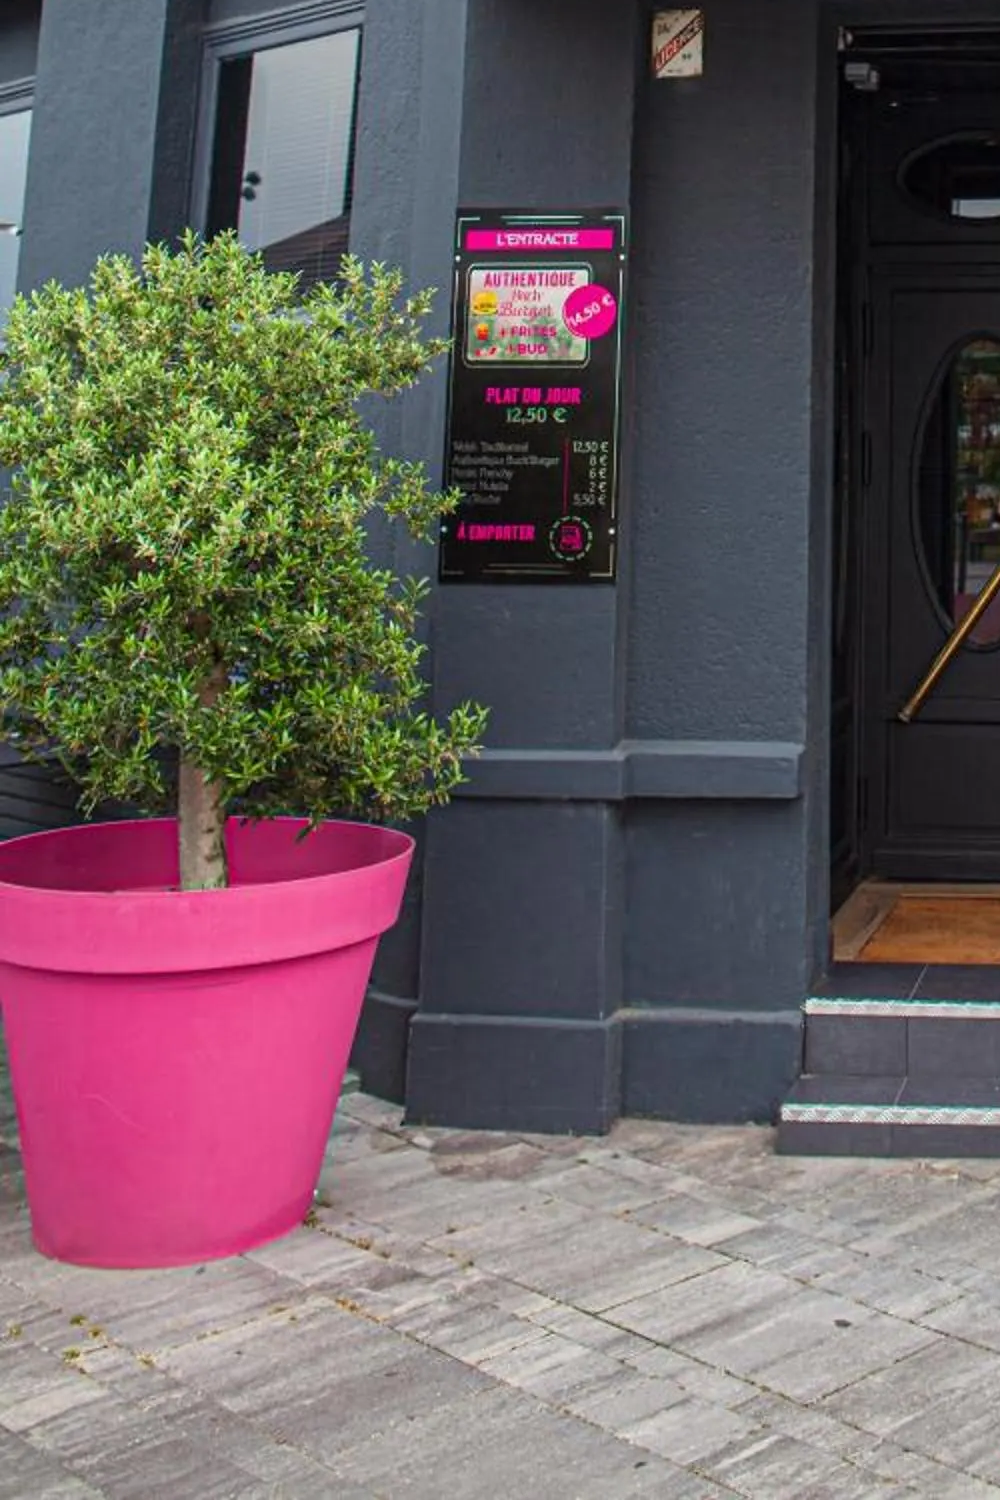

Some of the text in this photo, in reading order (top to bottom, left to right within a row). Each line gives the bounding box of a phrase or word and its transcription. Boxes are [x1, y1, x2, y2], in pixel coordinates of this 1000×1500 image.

[496, 231, 579, 246] L'ENTRACTE
[484, 272, 577, 288] AUTHENTIQUE
[516, 343, 548, 355] BUD
[485, 387, 518, 404] PLAT
[545, 387, 582, 404] JOUR
[553, 407, 567, 423] €
[469, 524, 536, 541] EMPORTER
